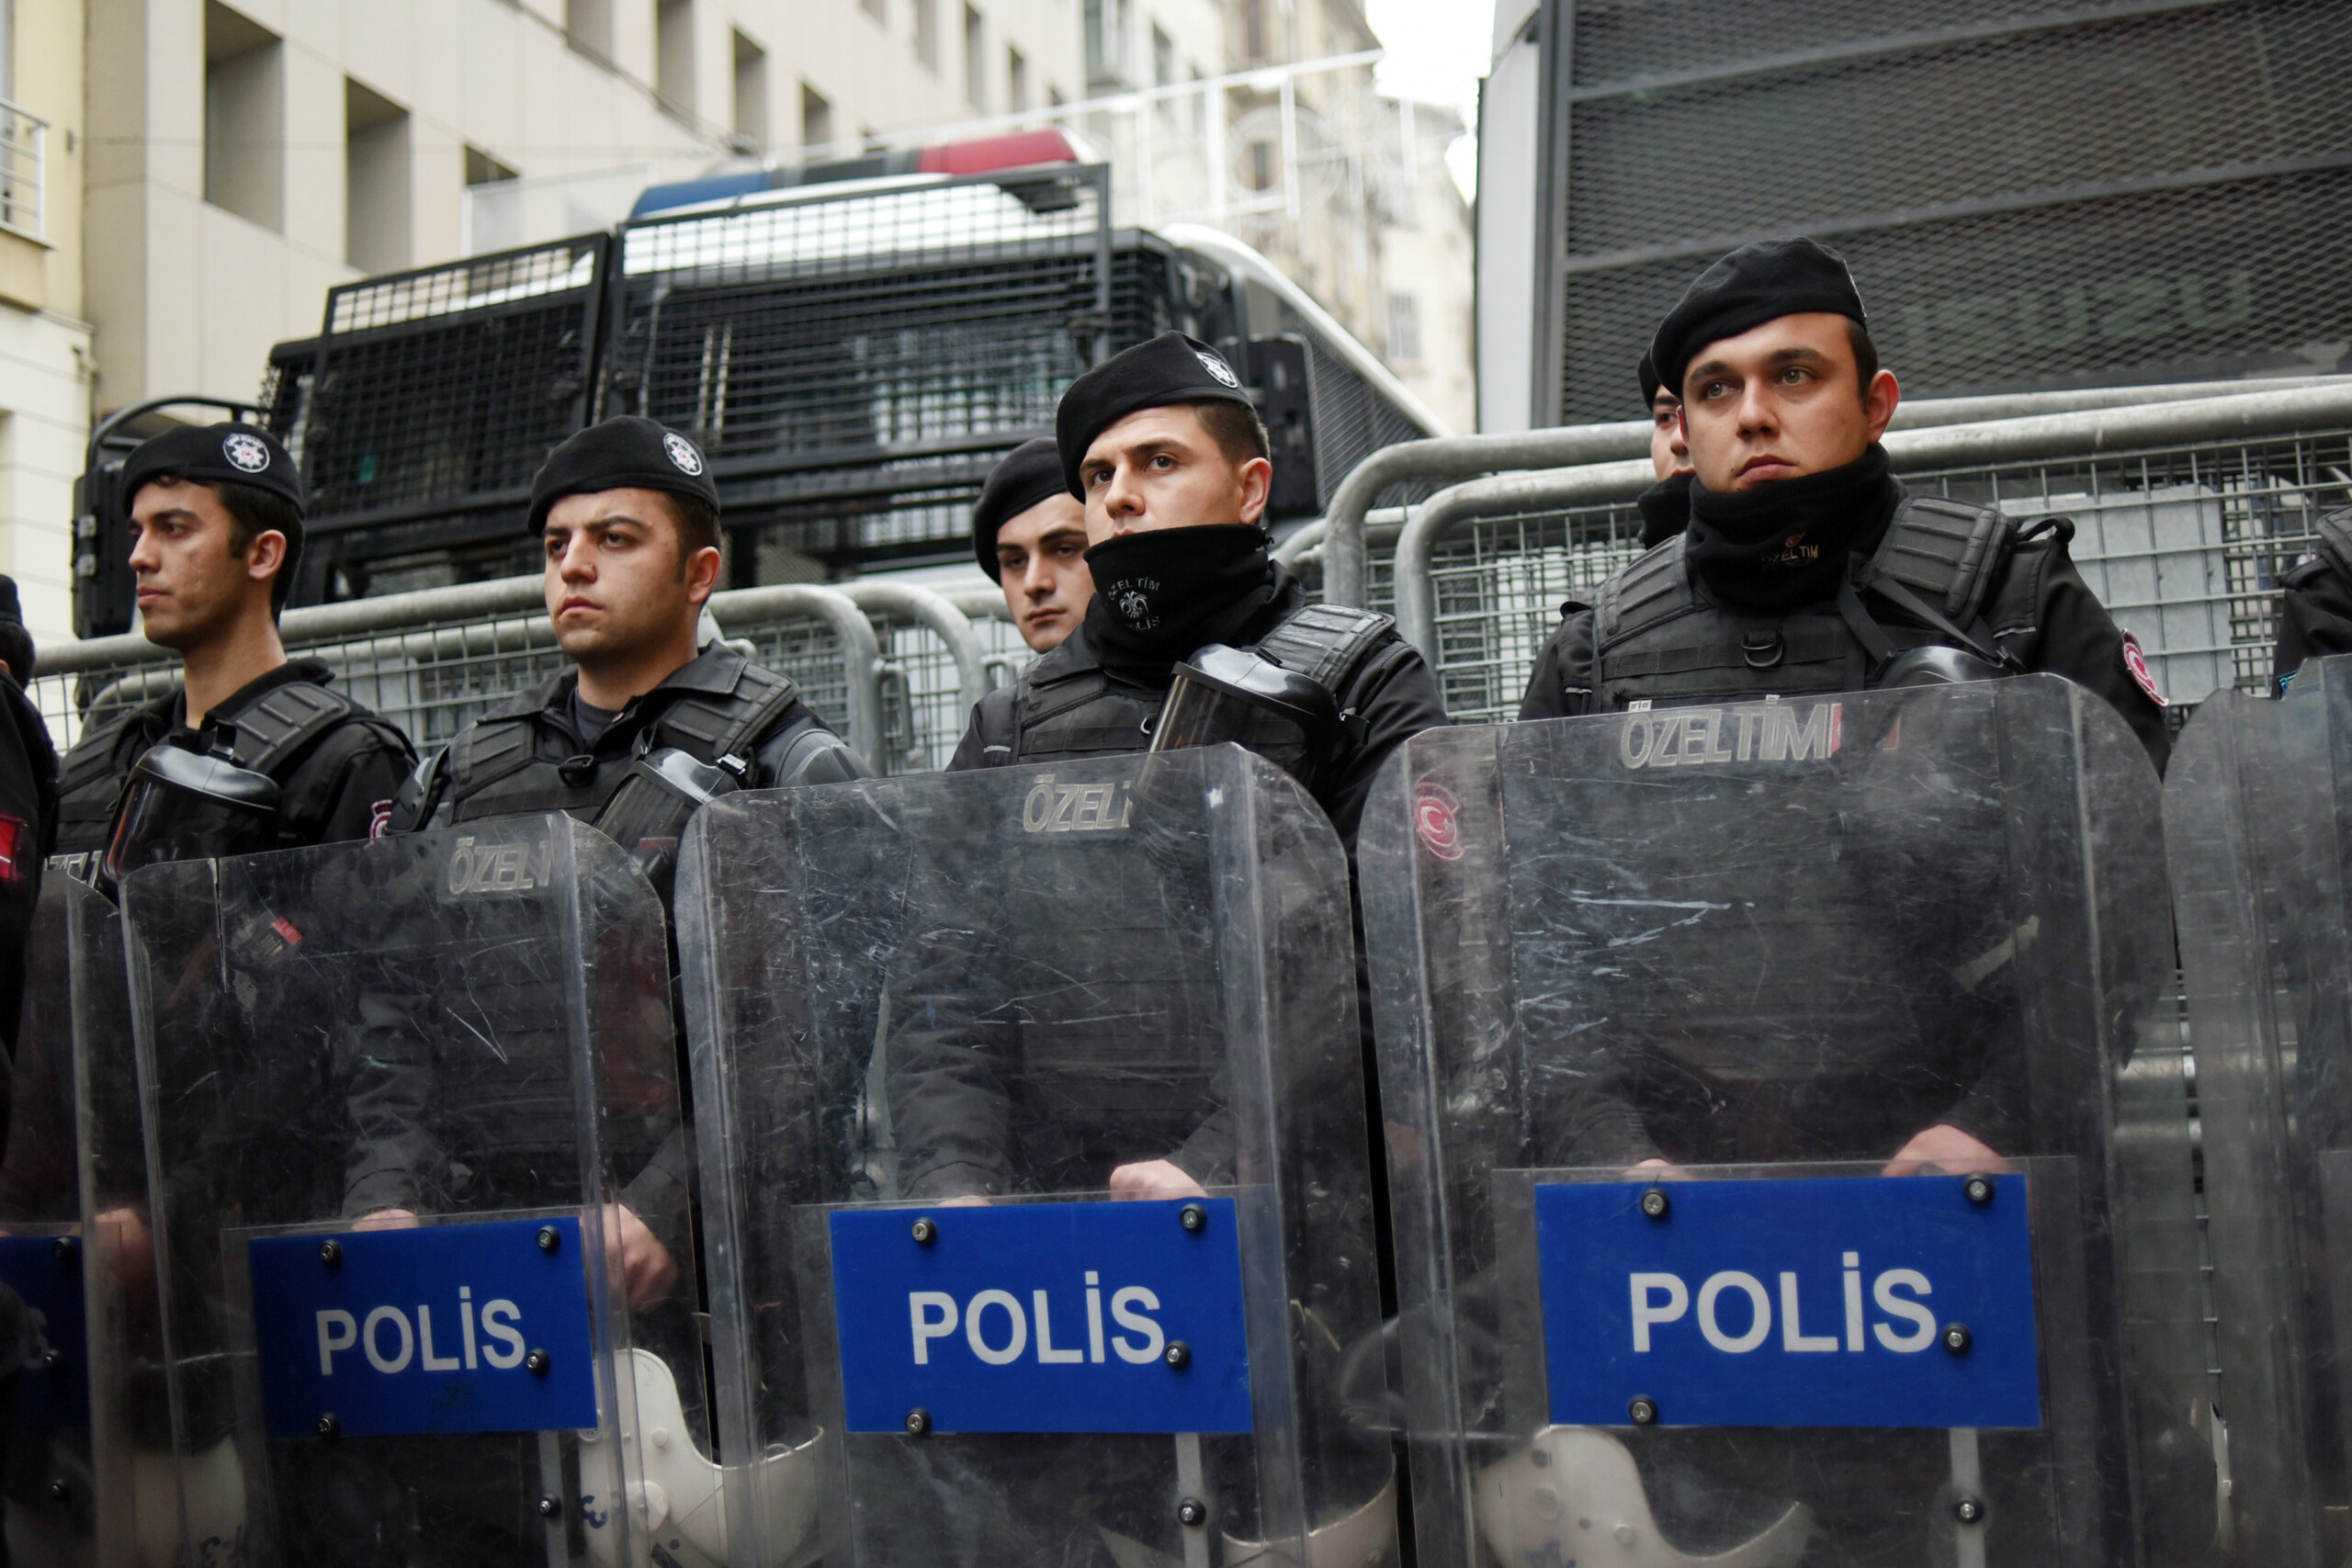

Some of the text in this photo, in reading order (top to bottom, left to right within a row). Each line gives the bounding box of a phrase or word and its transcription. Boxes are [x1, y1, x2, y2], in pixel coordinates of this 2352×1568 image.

[1900, 270, 2254, 354] ISUZU
[1621, 699, 1732, 770] ÖZEL
[315, 1286, 526, 1376] POLİS
[909, 1270, 1165, 1365] POLİS
[1630, 1251, 1938, 1353] POLİS
